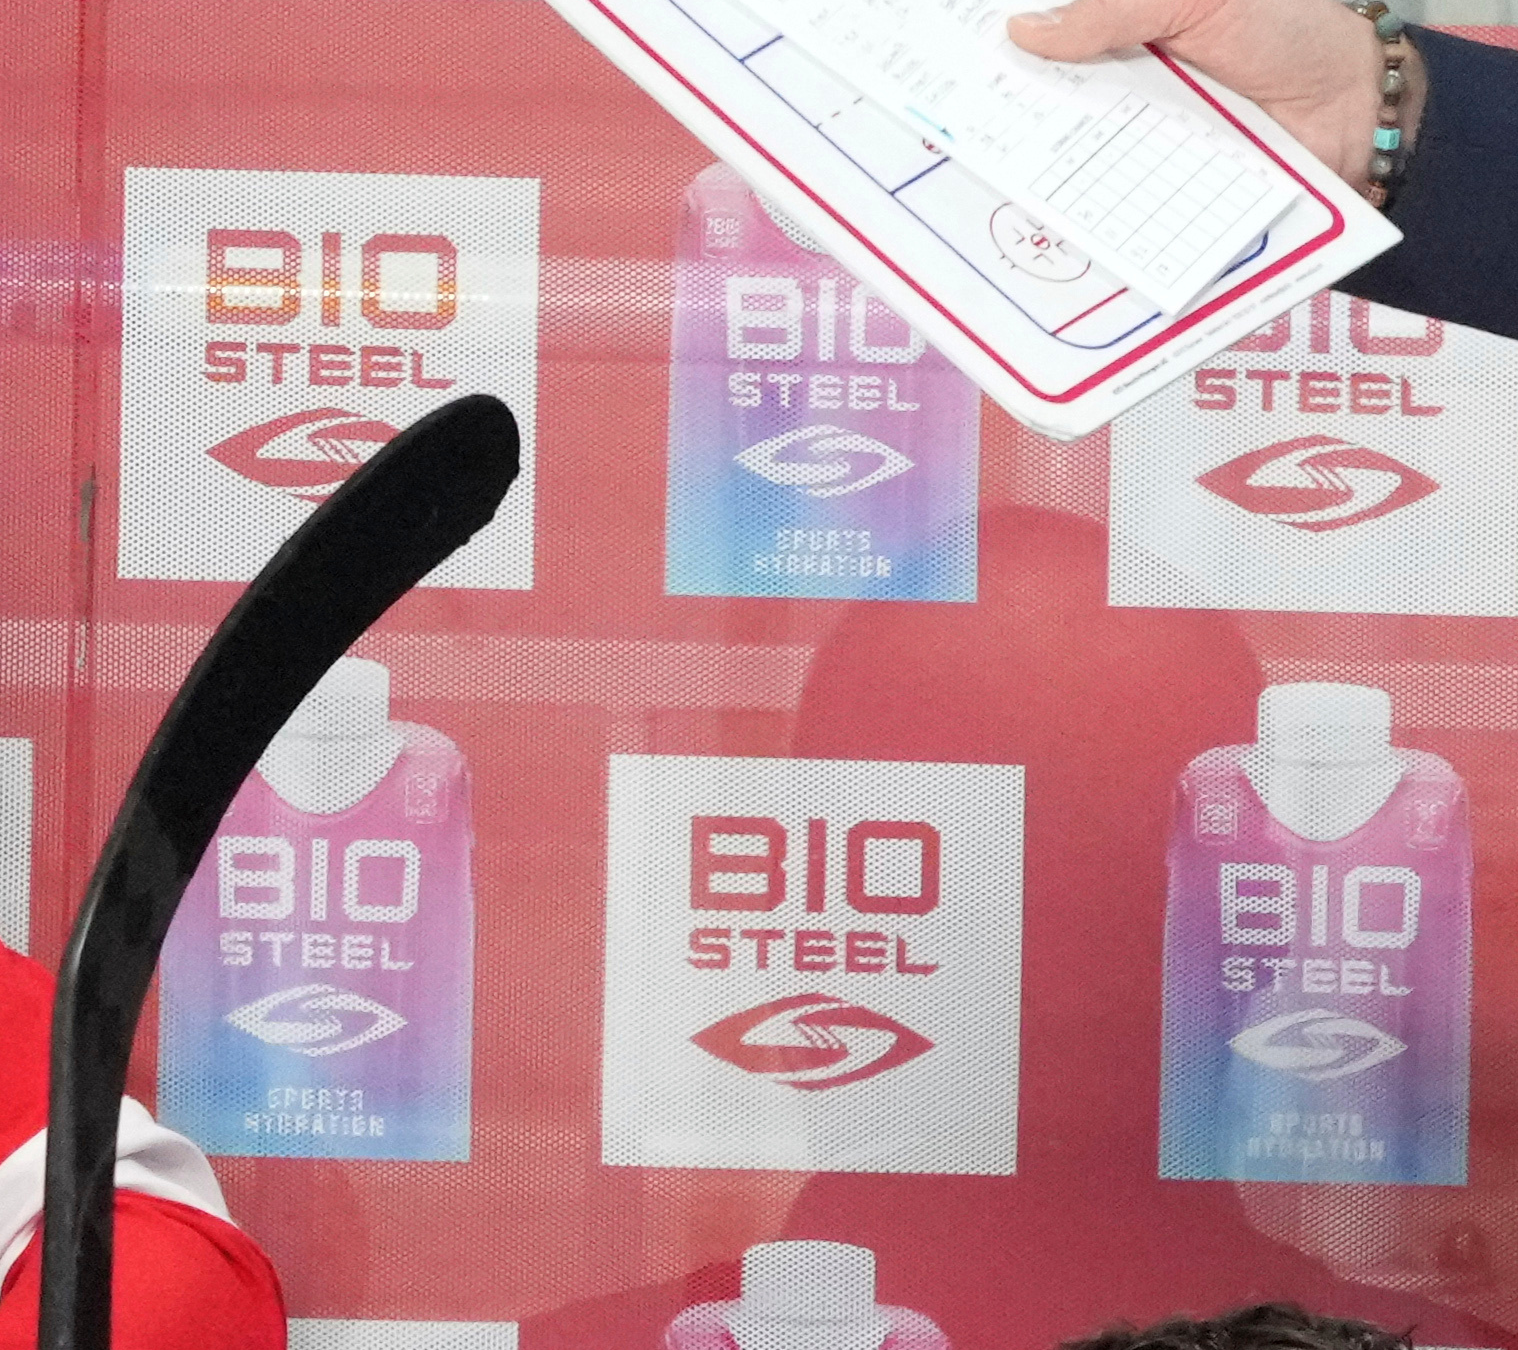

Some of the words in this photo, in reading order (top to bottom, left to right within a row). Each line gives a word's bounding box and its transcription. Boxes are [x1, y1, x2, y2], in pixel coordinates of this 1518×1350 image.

[205, 228, 457, 330] BIO
[204, 343, 456, 388] STEEL
[729, 373, 918, 412] STEEL
[1191, 373, 1444, 417] STEEL
[218, 838, 420, 924] BIO
[691, 816, 940, 915] BIO
[1220, 862, 1422, 952] BIO
[219, 933, 414, 971] STEEL
[689, 929, 938, 975] STEEL
[1222, 957, 1413, 996] STEEL
